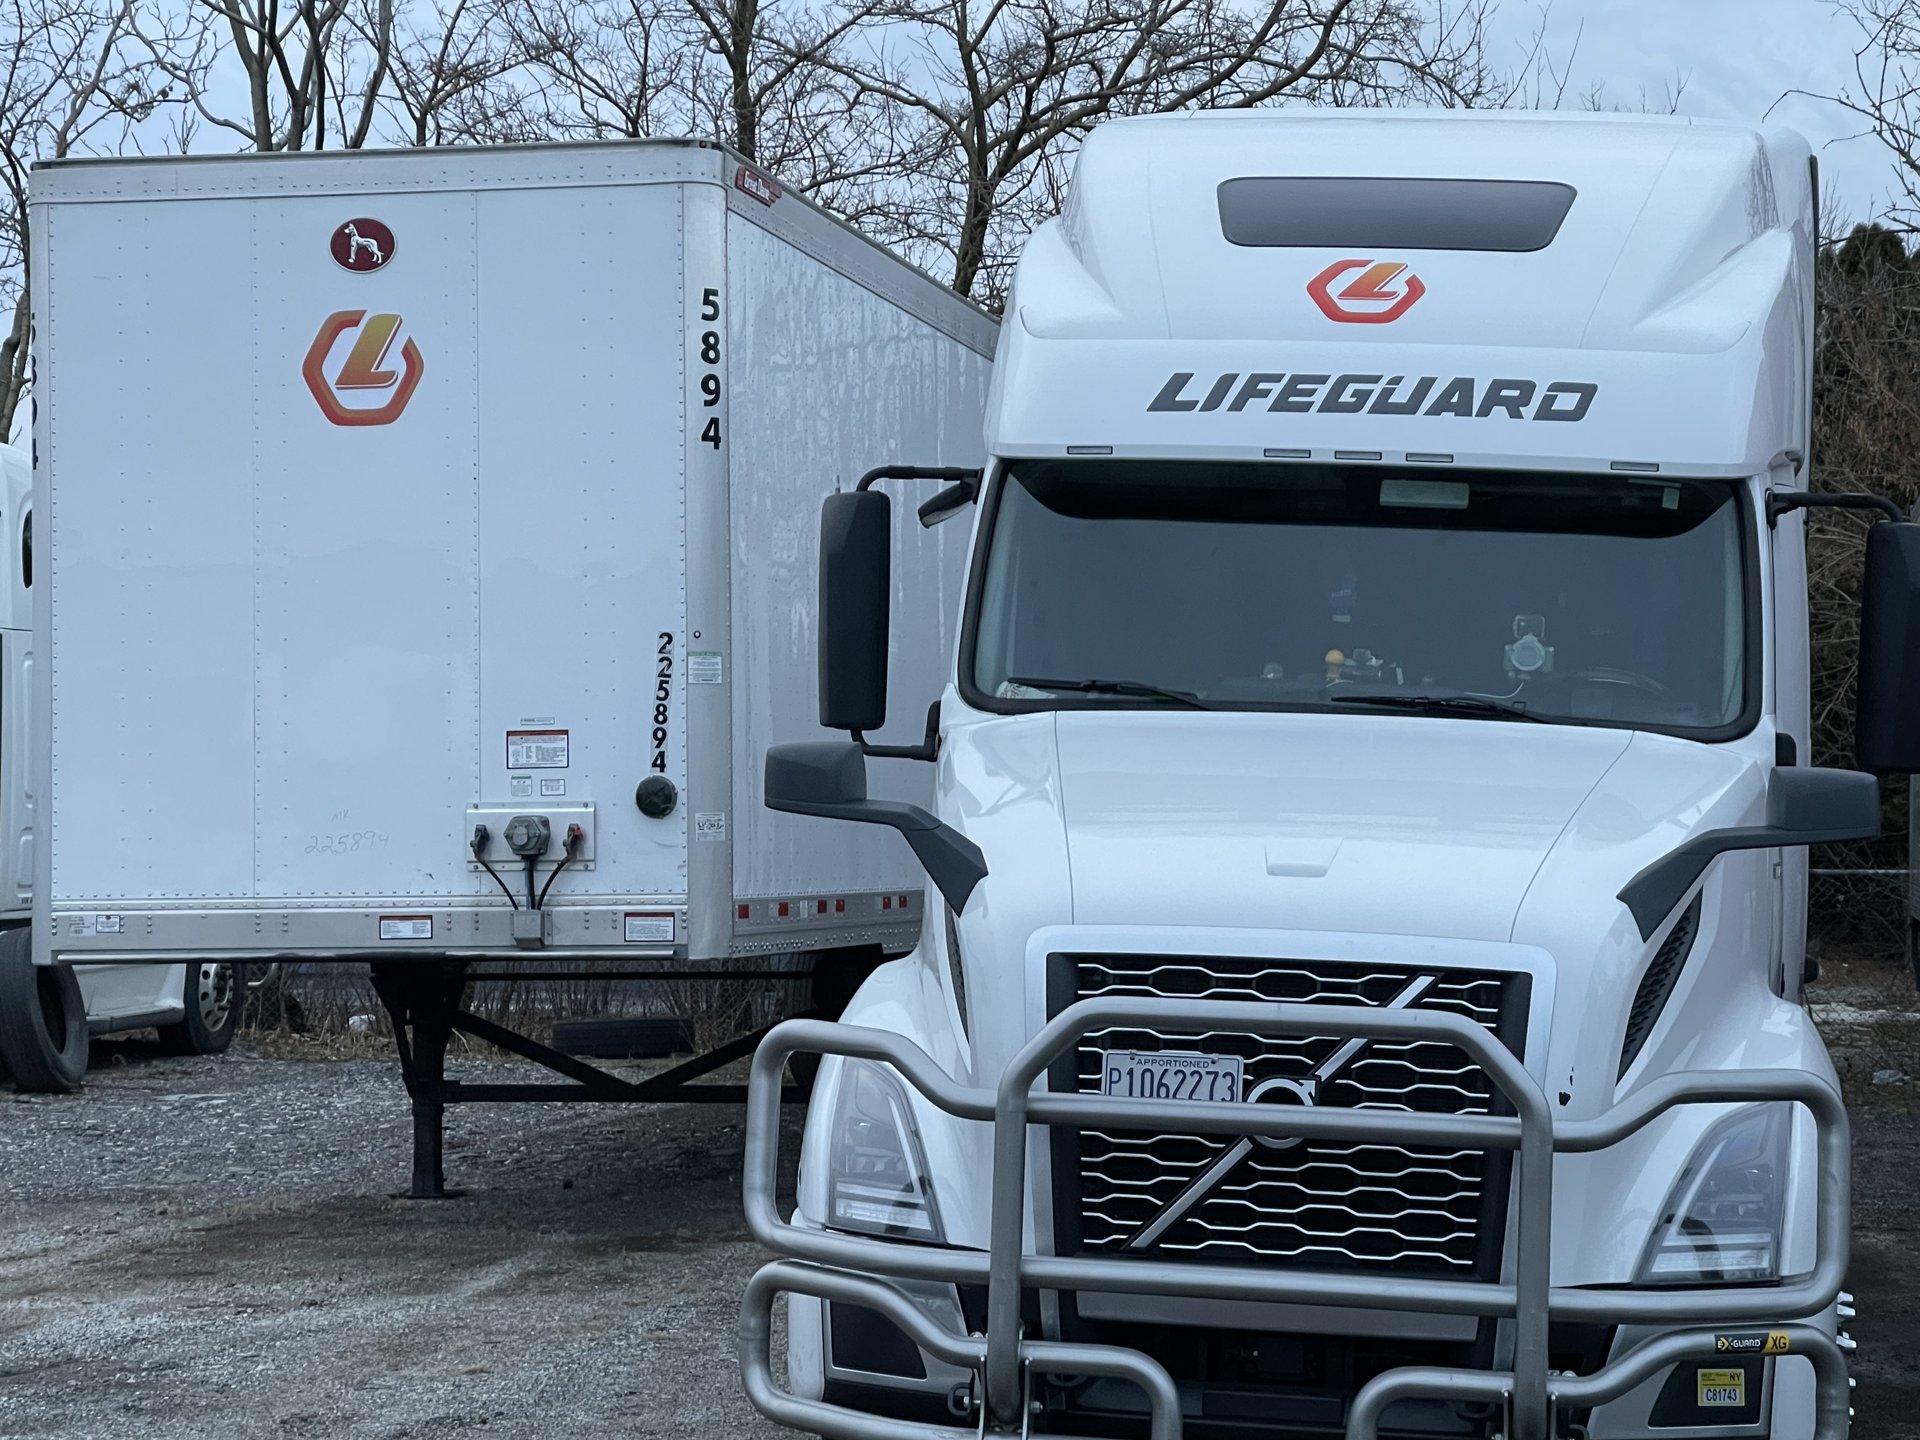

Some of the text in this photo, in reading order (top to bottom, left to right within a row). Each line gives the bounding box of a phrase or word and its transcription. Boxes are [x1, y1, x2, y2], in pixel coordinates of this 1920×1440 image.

[700, 287, 722, 450] 5894
[1146, 372, 1599, 422] LIFEGUARD
[651, 632, 673, 773] 225894
[304, 830, 391, 855] 225894
[1136, 1058, 1210, 1069] APPORTIONED
[1108, 1067, 1236, 1102] P1062273
[1771, 1336, 1787, 1350] XG
[1729, 1372, 1742, 1381] NY
[1705, 1388, 1737, 1402] C81743
